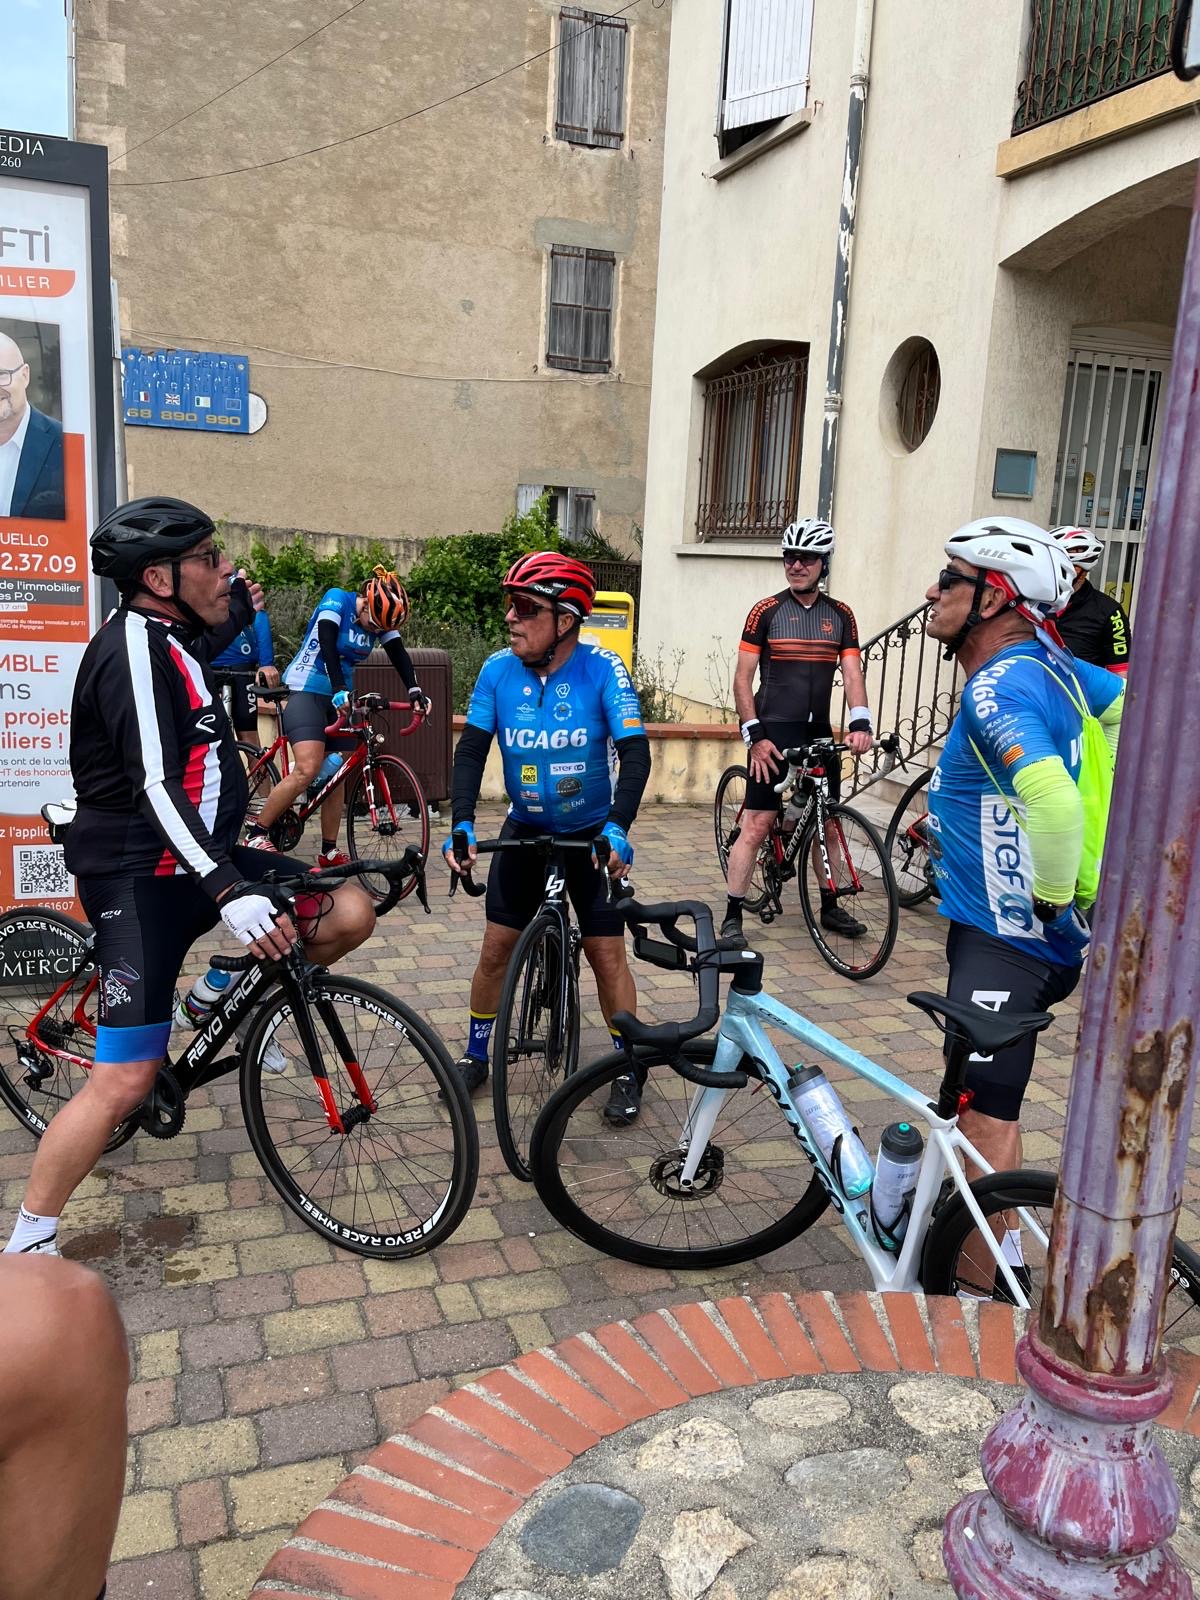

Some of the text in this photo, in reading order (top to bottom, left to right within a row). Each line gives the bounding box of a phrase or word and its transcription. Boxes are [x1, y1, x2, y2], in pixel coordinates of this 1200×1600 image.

[1, 155, 21, 168] 260
[161, 411, 197, 421] 890
[206, 415, 240, 425] 990
[0, 533, 49, 547] UELLO
[978, 548, 1011, 560] HJC
[1, 552, 76, 573] 2.37.09
[0, 581, 81, 592] de l'immobilier
[15, 592, 37, 601] P.O.
[5, 708, 71, 729] projet
[505, 728, 587, 749] VCA66
[29, 757, 41, 765] de
[44, 757, 51, 765] la
[15, 768, 31, 776] des
[784, 795, 815, 861] cannondale
[16, 921, 47, 931] RACE
[49, 924, 83, 949] WHEE
[14, 949, 44, 959] VOIR
[48, 948, 64, 957] AU
[187, 964, 262, 1068] REVO RACE
[320, 992, 409, 1038] RACE WHEEL
[299, 1194, 423, 1246] REVO RACE WHEEL
